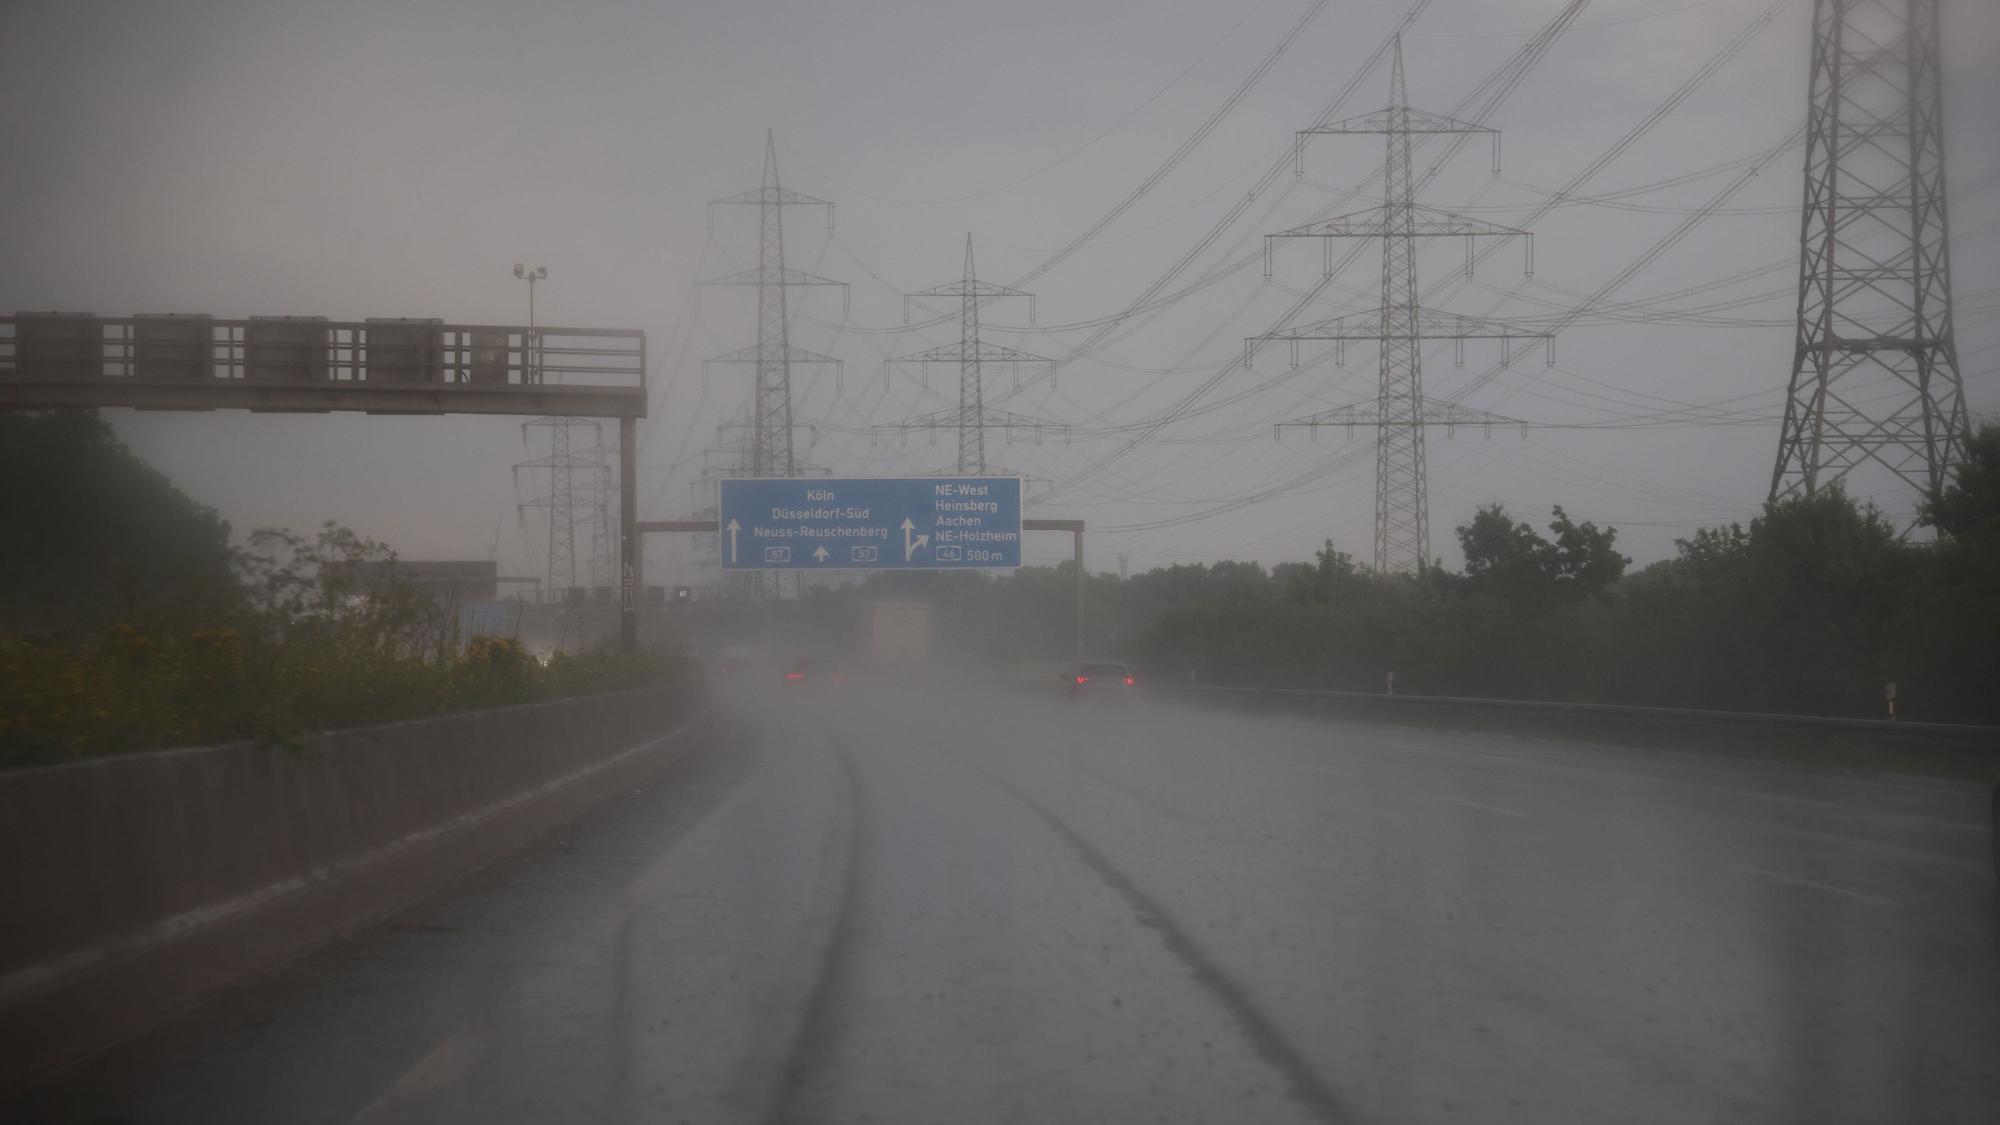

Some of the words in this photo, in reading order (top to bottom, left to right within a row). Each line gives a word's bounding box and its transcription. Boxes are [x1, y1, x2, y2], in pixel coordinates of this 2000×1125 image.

[807, 490, 834, 501] Köln
[935, 484, 989, 496] NE-West
[935, 500, 998, 514] Heinsberg
[772, 508, 870, 519] Düsseldorf-Süd
[936, 516, 981, 527] Aachen
[754, 526, 889, 540] Neuss-Reuschenberg
[935, 531, 1017, 542] NE-Holzheim
[771, 549, 784, 559] 57
[858, 549, 870, 559] 57
[943, 550, 955, 559] 46
[967, 551, 988, 561] 500
